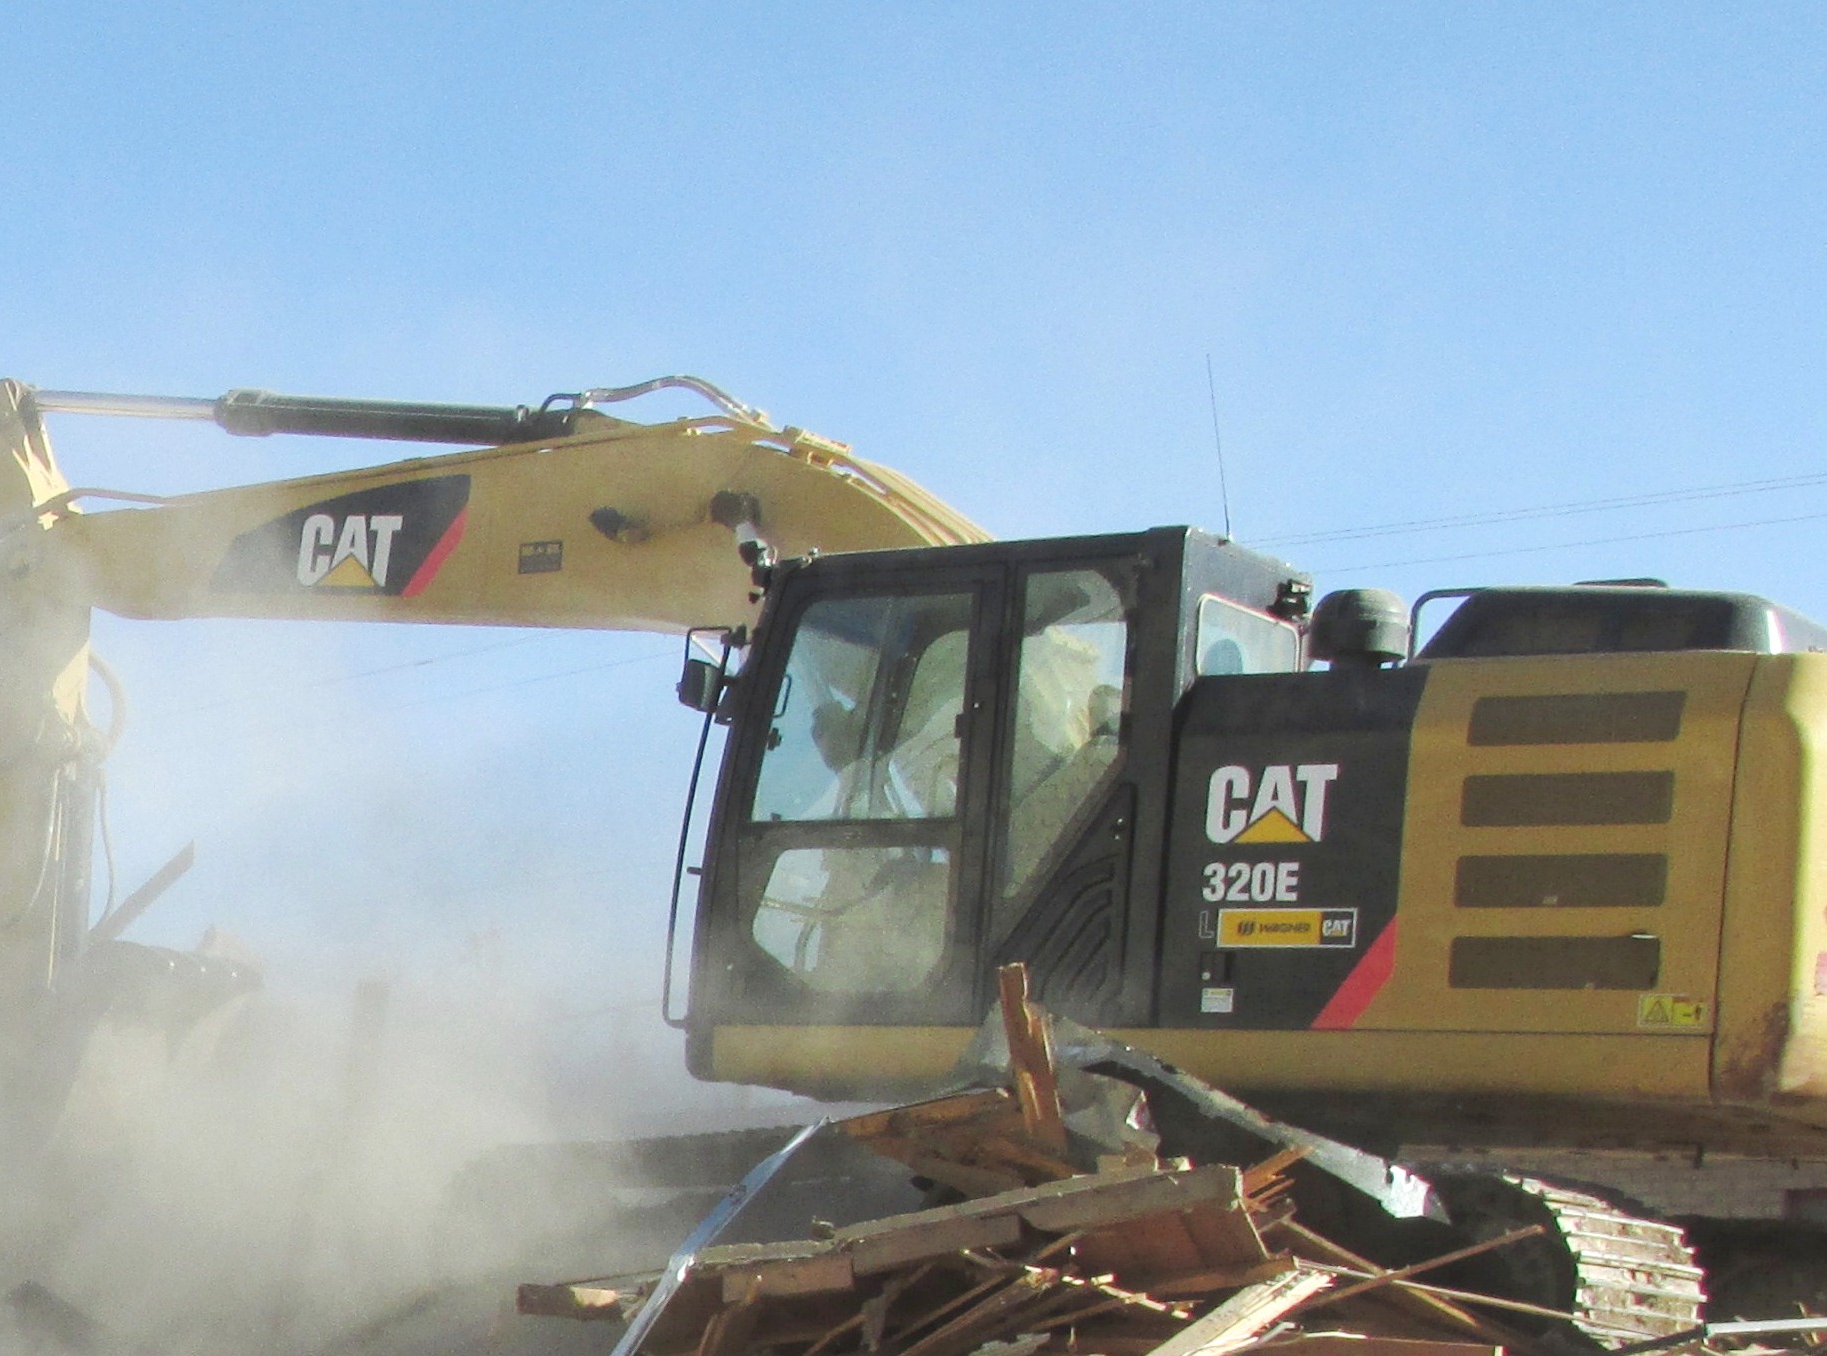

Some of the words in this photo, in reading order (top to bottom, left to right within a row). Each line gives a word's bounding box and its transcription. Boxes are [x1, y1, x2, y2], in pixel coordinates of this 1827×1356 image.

[296, 513, 404, 588] CAT
[1205, 763, 1338, 844] CAT
[1201, 862, 1300, 902] 320E
[1322, 918, 1352, 938] CAT
